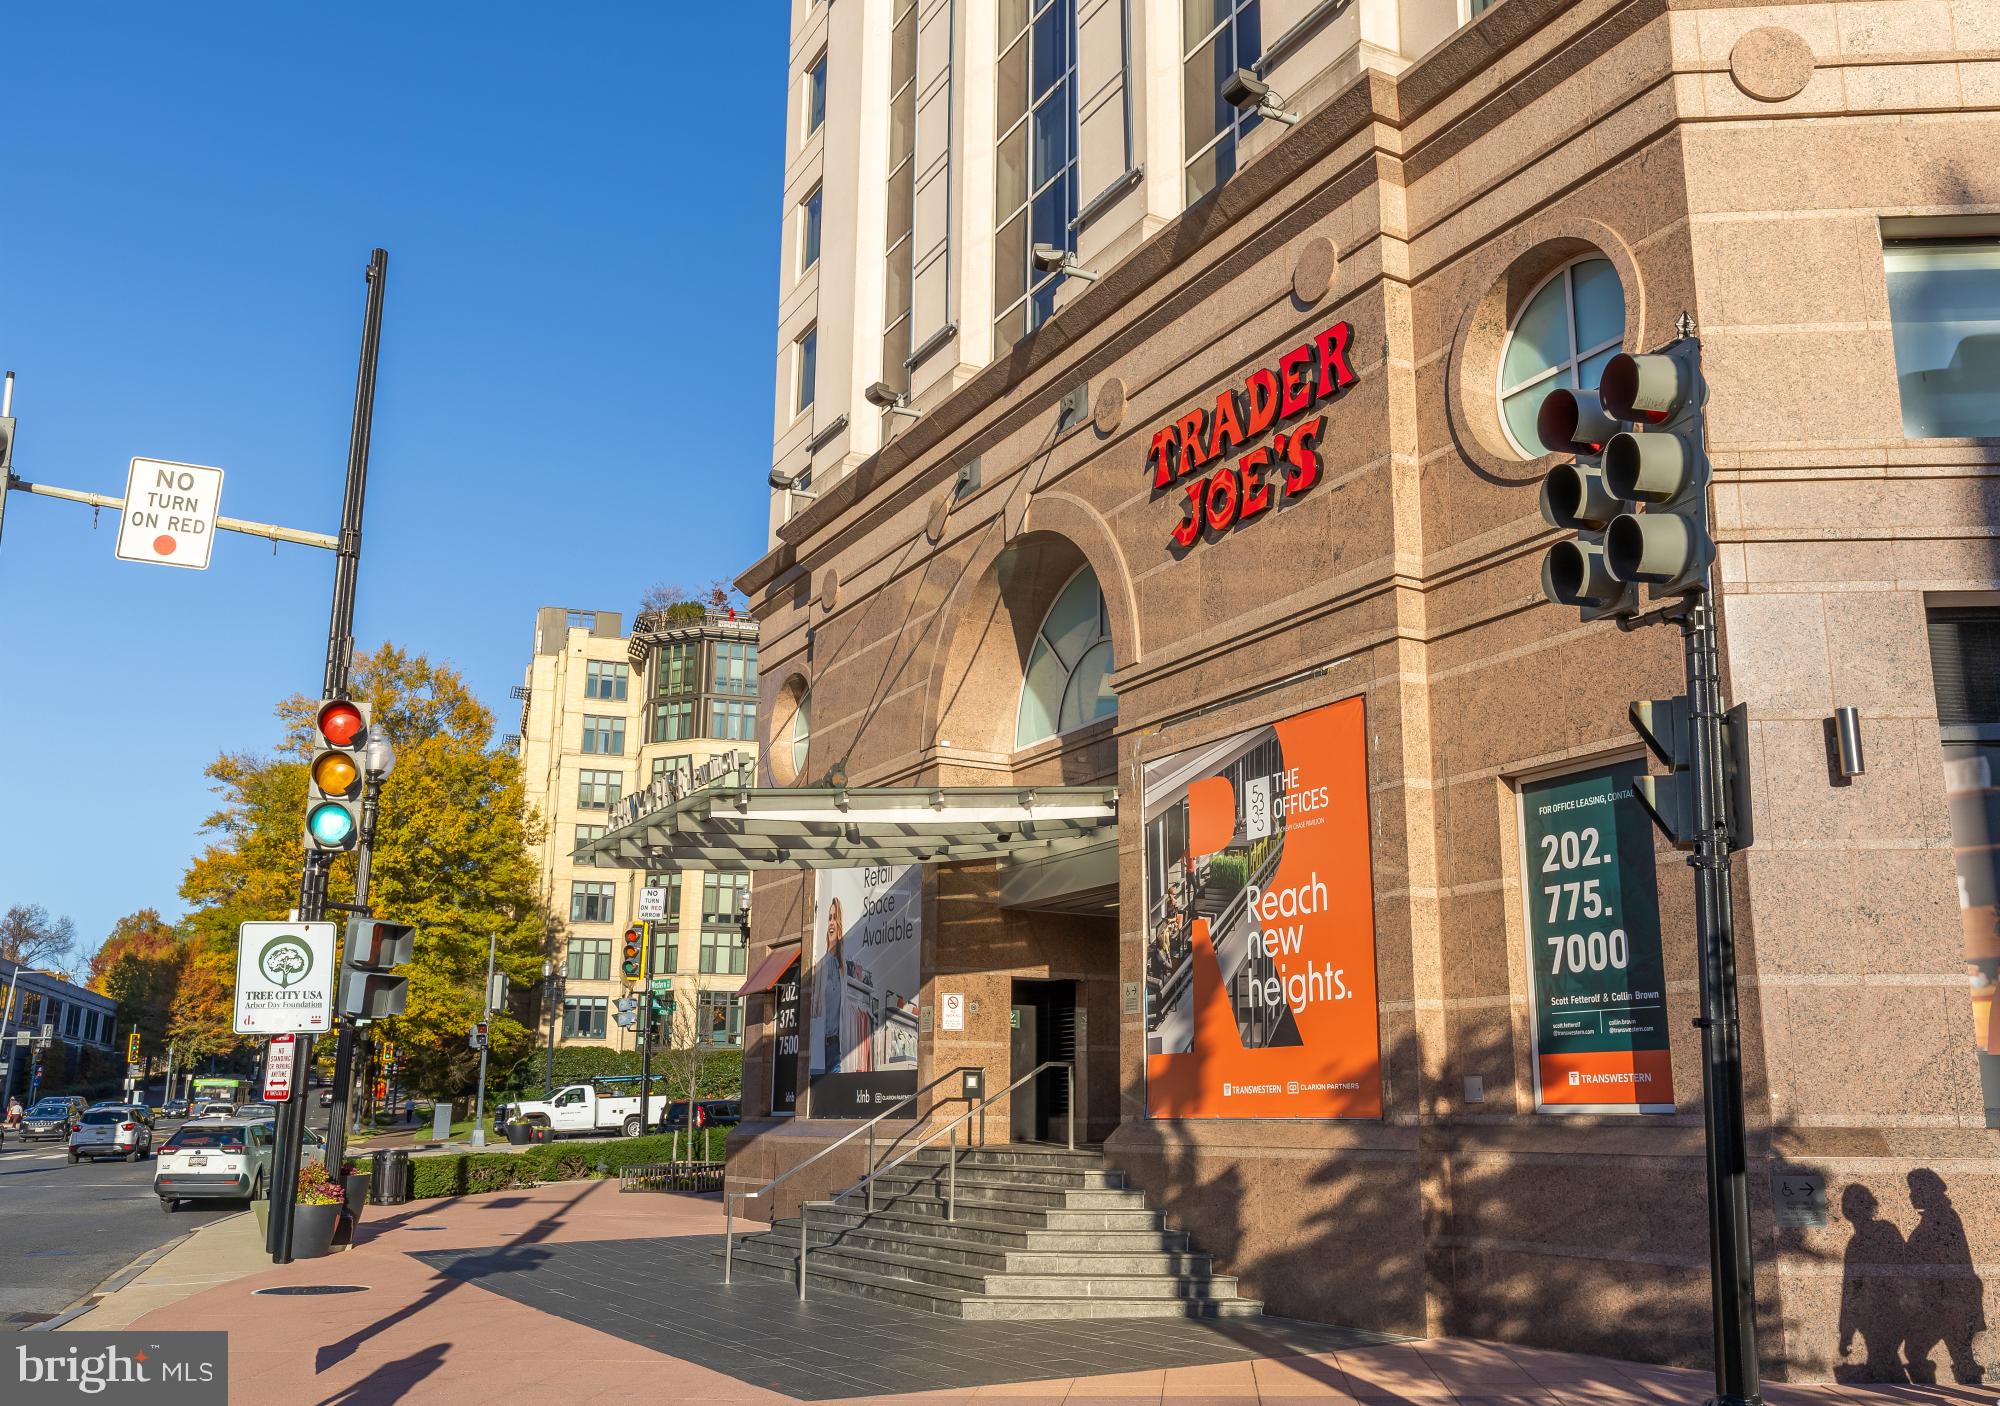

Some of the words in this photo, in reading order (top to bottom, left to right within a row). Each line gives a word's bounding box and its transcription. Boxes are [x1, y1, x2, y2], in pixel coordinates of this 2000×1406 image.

[1149, 320, 1360, 489] TRADER
[156, 469, 194, 491] NO
[1171, 415, 1328, 547] JOE'S
[148, 492, 198, 513] TURN
[132, 511, 159, 529] ON
[168, 516, 205, 534] RED
[1273, 767, 1300, 793] THE
[1273, 786, 1329, 819] OFFICES
[1539, 805, 1552, 816] FOR
[1552, 801, 1575, 813] OFFICE
[1575, 795, 1607, 809] LEASING,
[1541, 827, 1612, 873] 202.
[864, 865, 893, 889] Retail
[863, 895, 895, 922] Space
[1247, 872, 1328, 923] Reach
[1544, 879, 1613, 924] 775.
[862, 917, 913, 947] Available
[1247, 925, 1304, 960] new
[1547, 928, 1629, 975] 7000
[245, 991, 274, 1000] TREE
[275, 991, 301, 1000] CITY
[302, 990, 323, 999] USA
[1248, 960, 1353, 1014] heights.
[1551, 996, 1569, 1006] Scott
[1570, 993, 1601, 1005] Fetterolf
[1603, 994, 1609, 1002] &
[1611, 991, 1632, 1002] Collin
[1635, 990, 1660, 1000] Brown
[245, 1001, 266, 1009] Arbor
[267, 1001, 280, 1009] Day
[282, 1000, 323, 1008] Foundation
[779, 1008, 797, 1029] 375.
[779, 1034, 799, 1055] 7500
[1232, 1084, 1282, 1095] TRANSWESTERN
[1300, 1082, 1326, 1091] CLARION
[1326, 1082, 1360, 1090] PARTNERS
[1581, 1072, 1651, 1084] TRANSWESTERN
[856, 1089, 870, 1103] klnb
